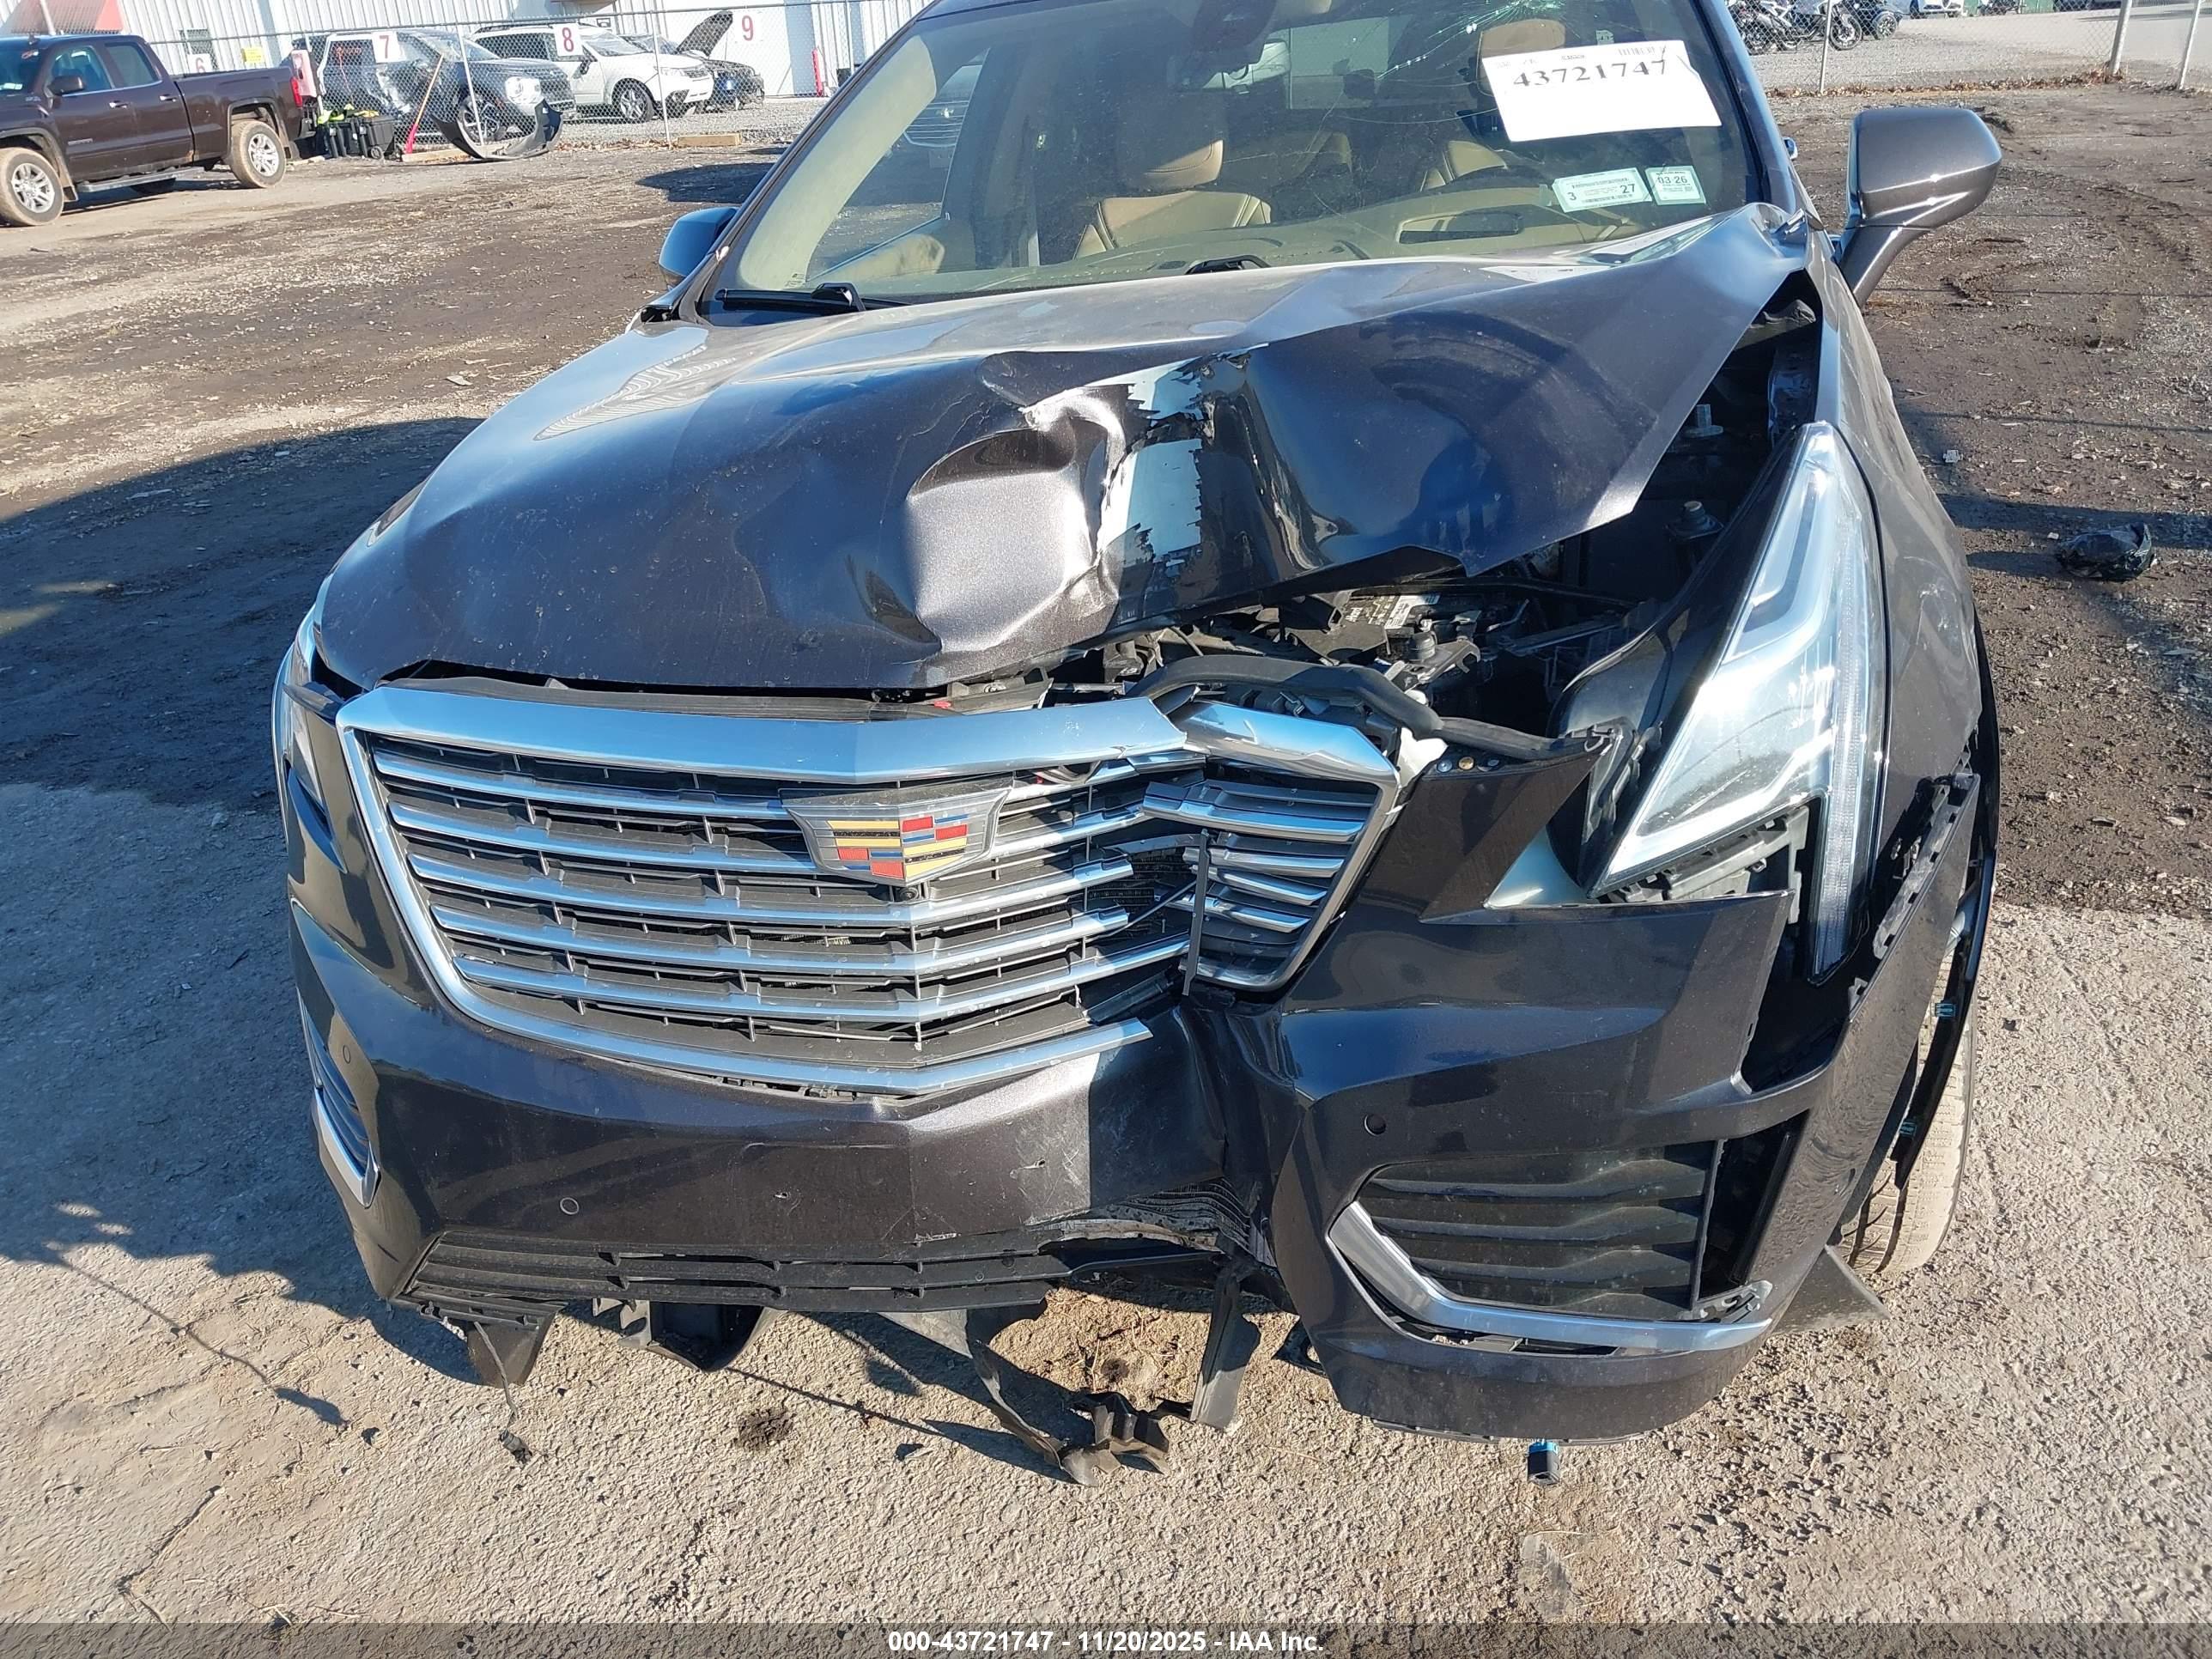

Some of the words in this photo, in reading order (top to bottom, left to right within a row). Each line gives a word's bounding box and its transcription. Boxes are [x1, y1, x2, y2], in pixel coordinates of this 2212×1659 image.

[562, 27, 574, 52] 8
[741, 15, 754, 41] 9
[379, 34, 389, 59] 7
[1513, 59, 1666, 87] 43721747
[1567, 191, 1577, 201] 3
[1620, 183, 1636, 195] 27
